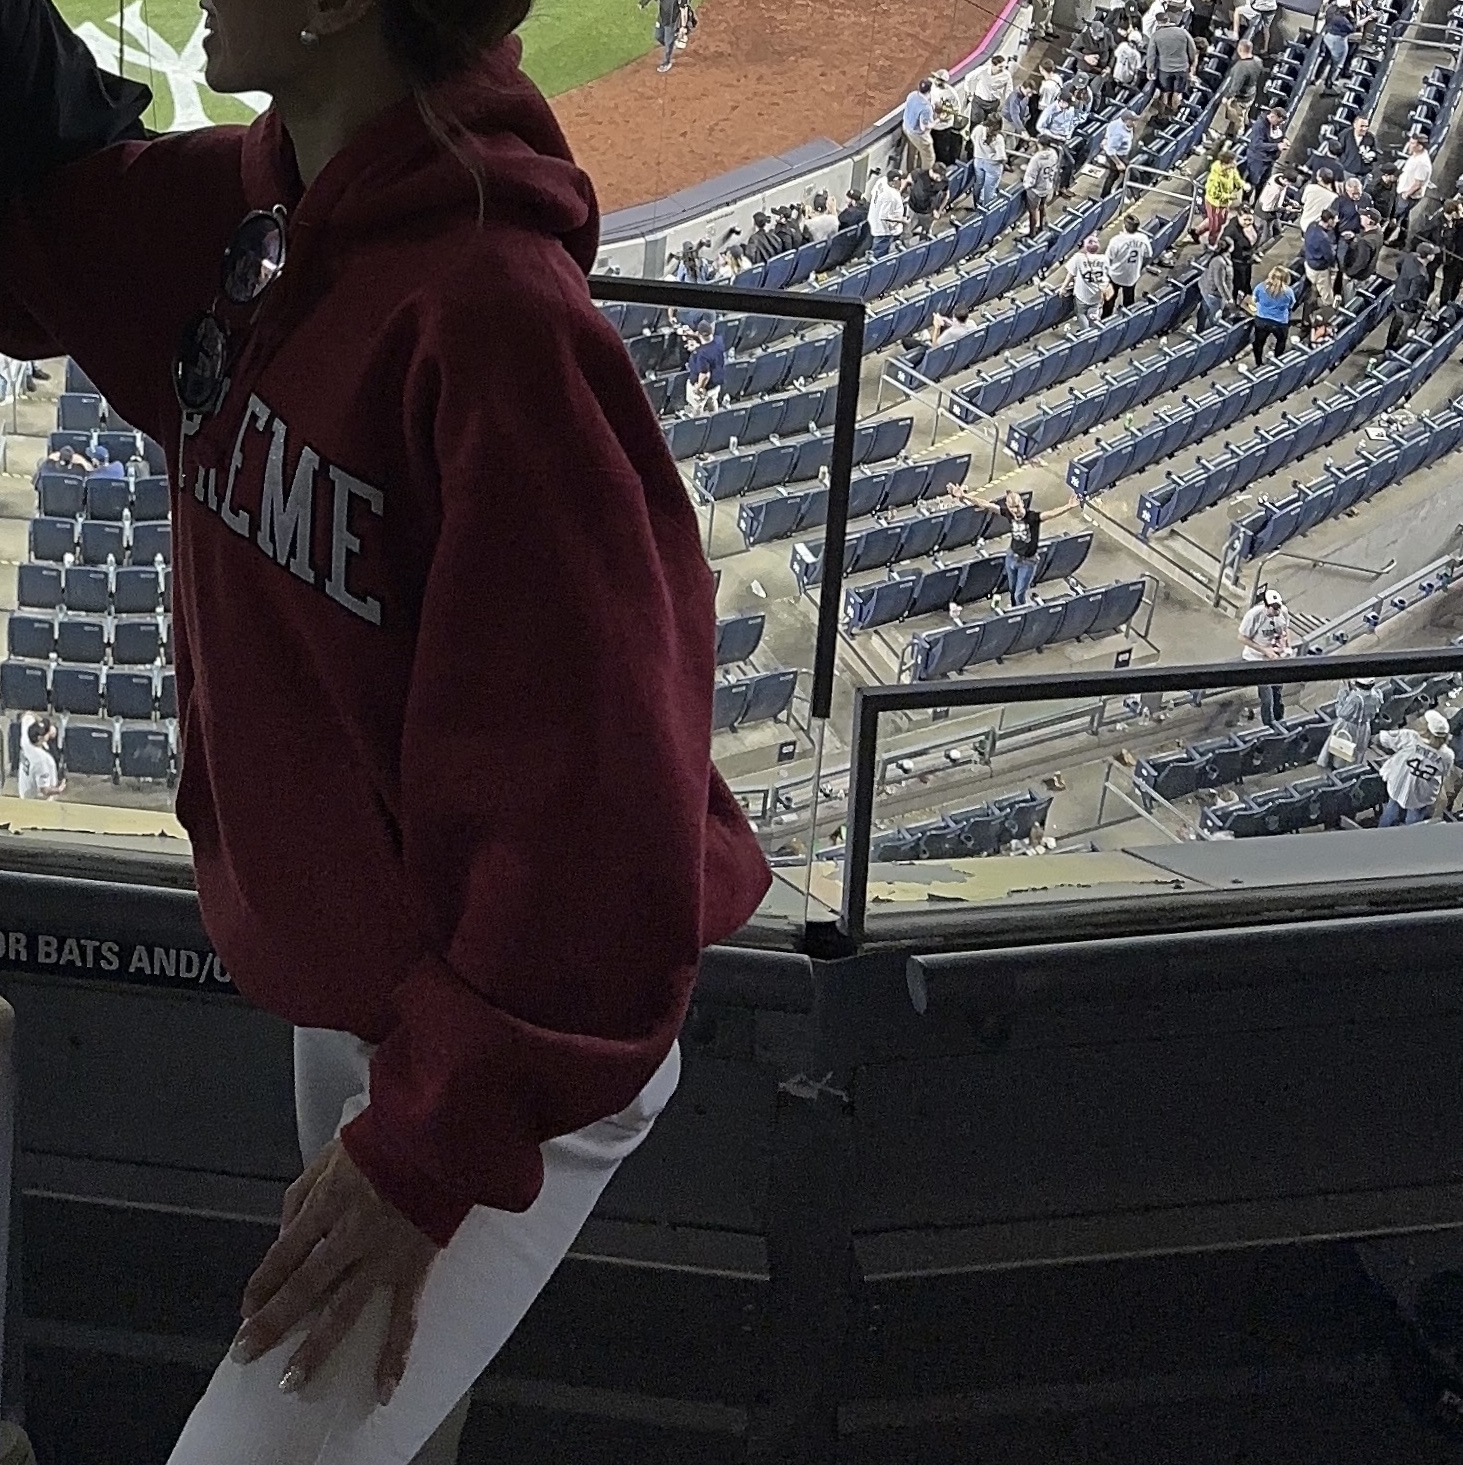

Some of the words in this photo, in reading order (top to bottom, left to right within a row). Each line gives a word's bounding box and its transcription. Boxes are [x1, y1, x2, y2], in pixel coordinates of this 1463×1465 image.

[1127, 250, 1138, 264] 2
[1083, 270, 1105, 283] 42
[1406, 757, 1438, 781] 42
[37, 935, 120, 971] BATS
